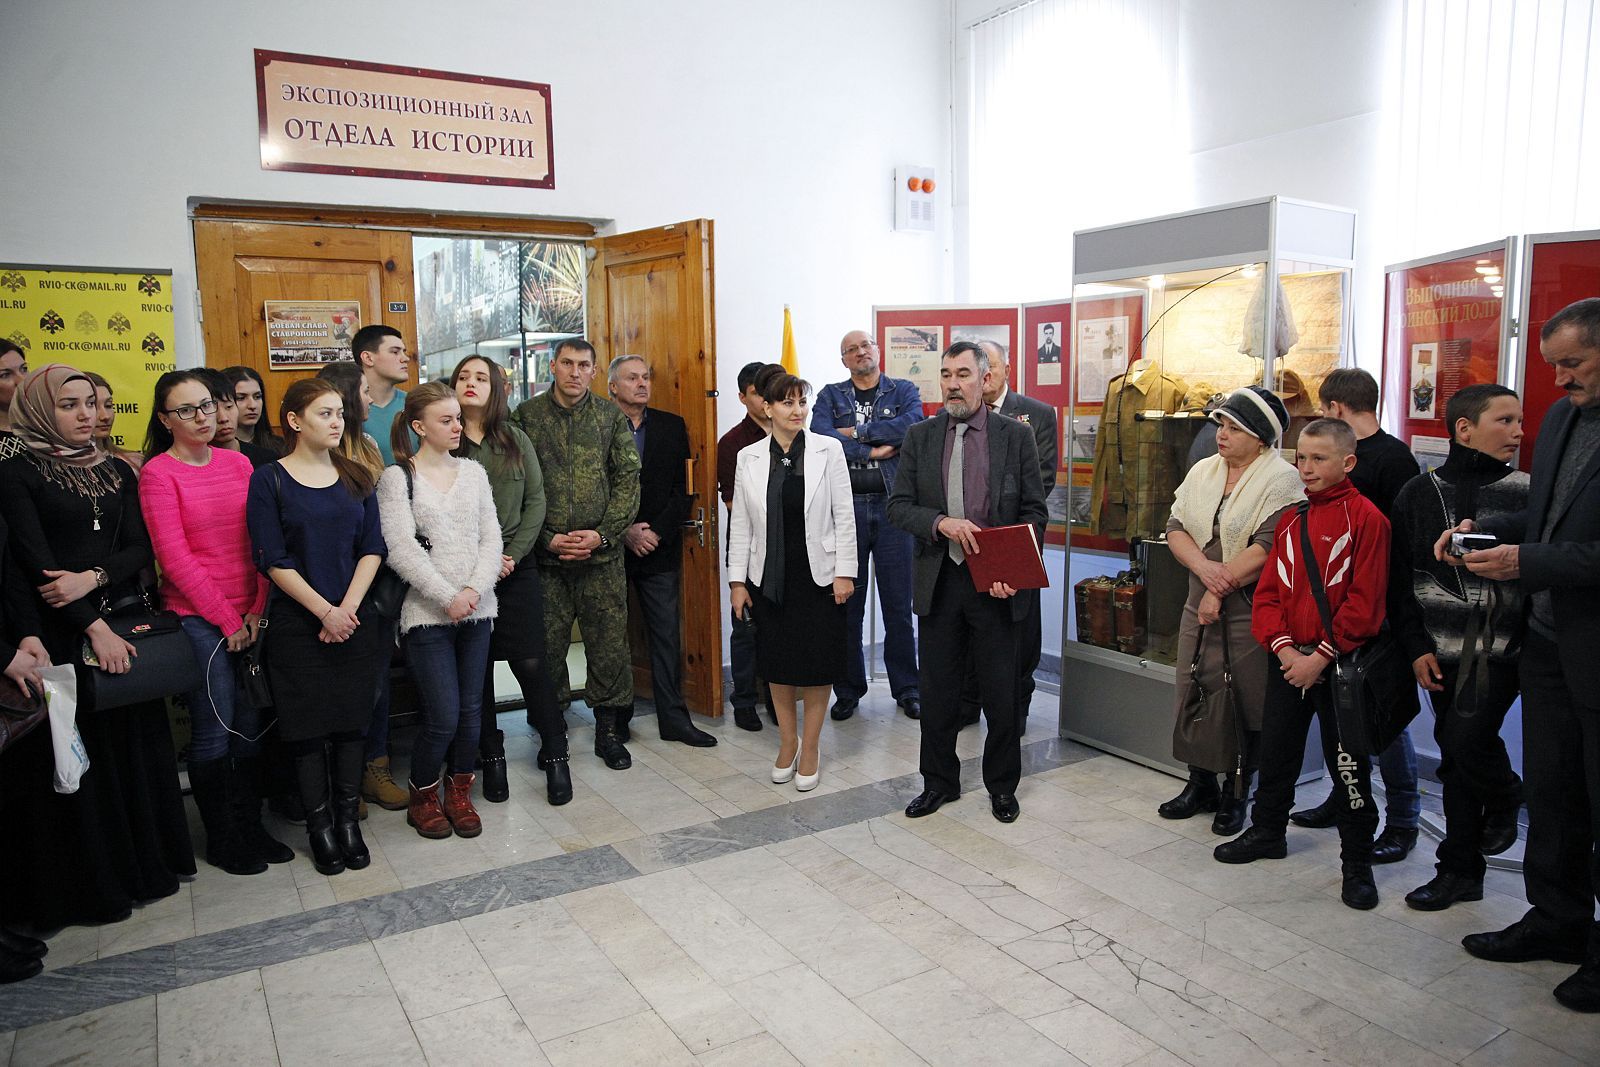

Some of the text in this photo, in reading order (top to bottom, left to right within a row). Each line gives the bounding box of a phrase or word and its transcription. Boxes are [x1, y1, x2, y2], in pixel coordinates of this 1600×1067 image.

[281, 83, 534, 125] ЭКСПОЗИЦИОННЫЙ ЗАЛ
[284, 118, 535, 159] ОТДЕЛА ИСТОРИИ
[39, 280, 127, 292] RVIO-CK@MAIL.RU
[1406, 278, 1479, 305] ВЫПОЛНЯЯ
[43, 341, 131, 352] RVIO-CK@MAIL.RU
